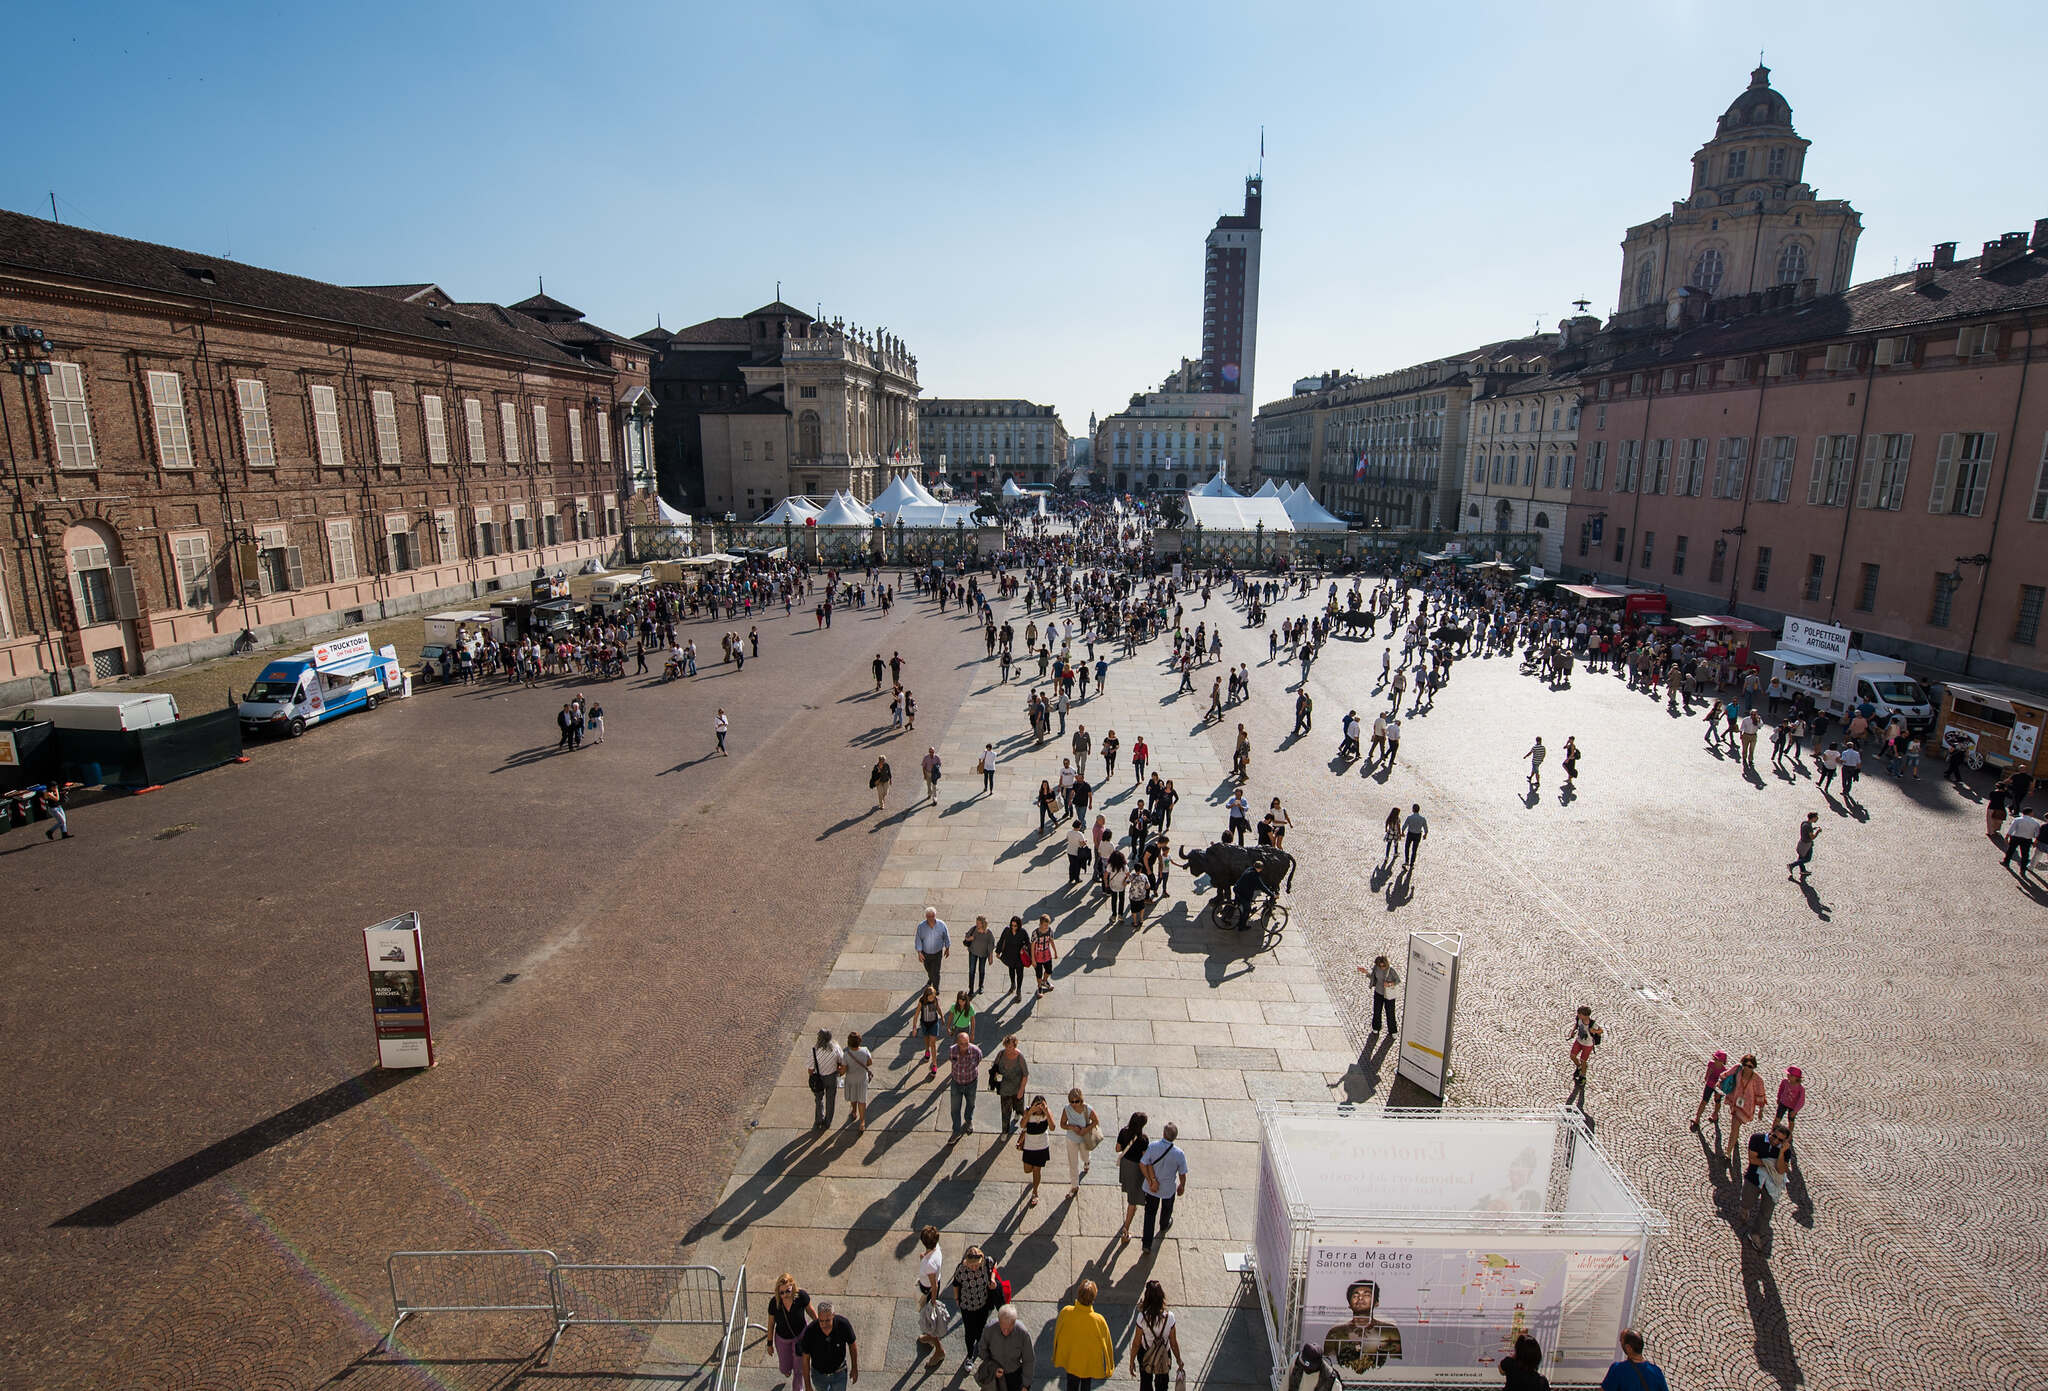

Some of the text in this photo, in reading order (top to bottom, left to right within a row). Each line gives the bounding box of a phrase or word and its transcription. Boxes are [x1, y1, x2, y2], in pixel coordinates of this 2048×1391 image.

[1804, 626, 1846, 644] POLPETTERIA
[329, 637, 368, 652] TRUCKTORIA
[1806, 638, 1840, 653] ARTIGIANA
[1318, 1250, 1413, 1261] Terra Madre
[1316, 1260, 1412, 1269] Salone del Gusto
